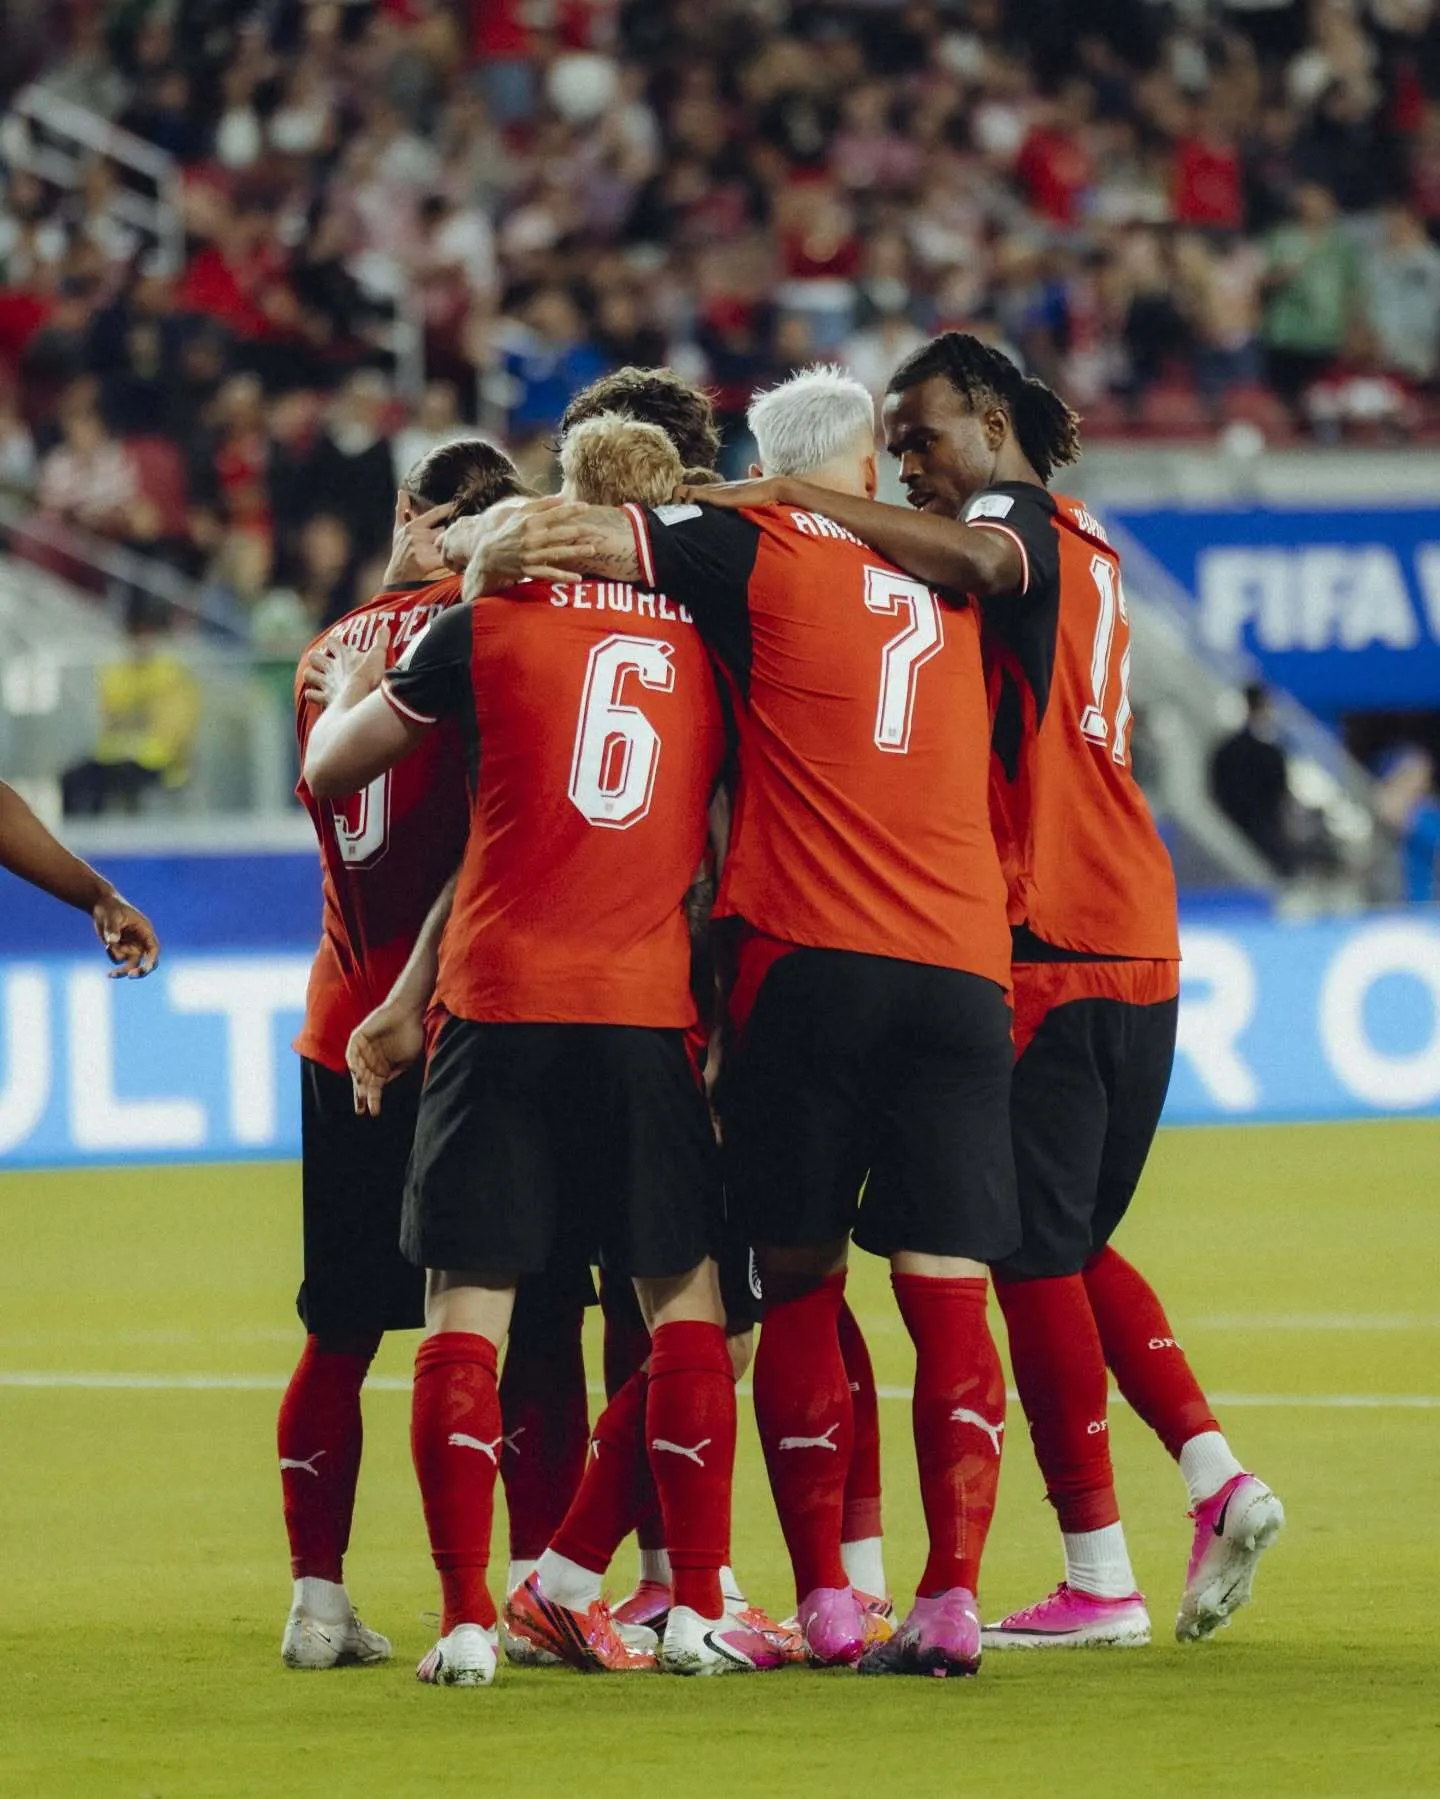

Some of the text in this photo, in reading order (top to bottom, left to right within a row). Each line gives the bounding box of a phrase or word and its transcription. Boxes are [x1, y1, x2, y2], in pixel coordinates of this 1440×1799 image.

[863, 564, 945, 754] 7
[1198, 545, 1418, 652] FIFA
[567, 634, 676, 831] 6
